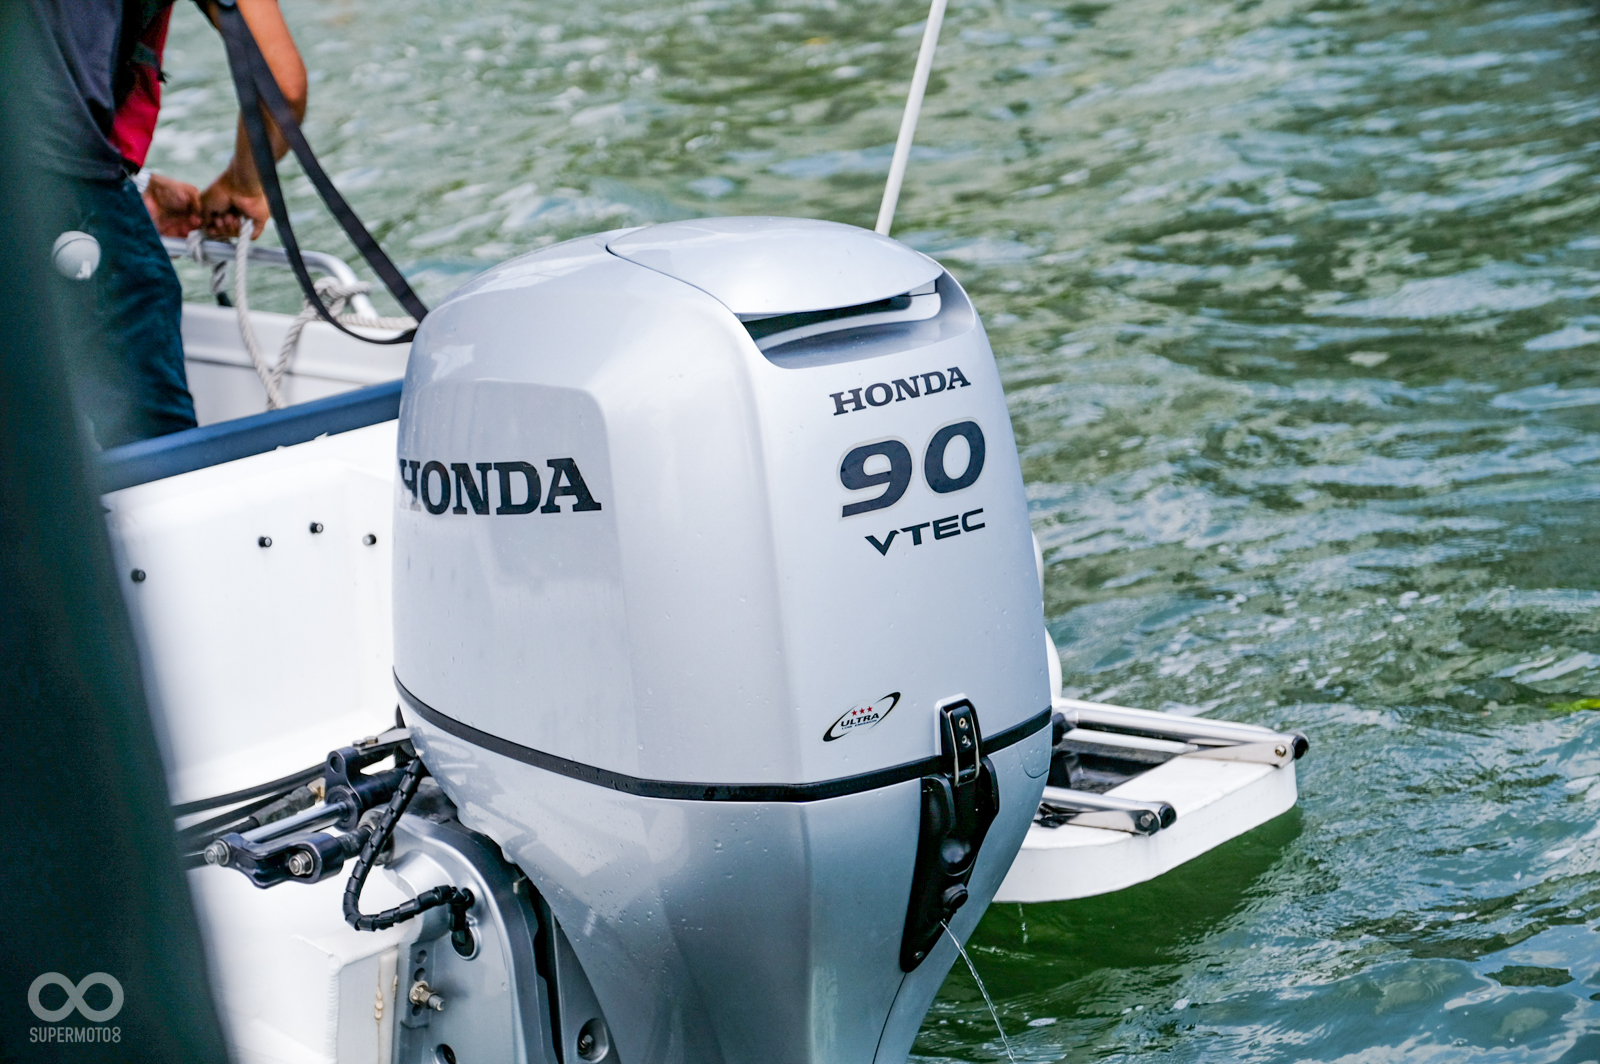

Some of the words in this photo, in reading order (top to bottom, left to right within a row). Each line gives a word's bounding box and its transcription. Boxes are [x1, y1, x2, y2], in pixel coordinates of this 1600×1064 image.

[830, 366, 971, 416] HONDA
[399, 457, 602, 516] HONDA
[839, 420, 987, 519] 90
[865, 508, 986, 556] VTEC
[841, 713, 879, 727] ULTRA
